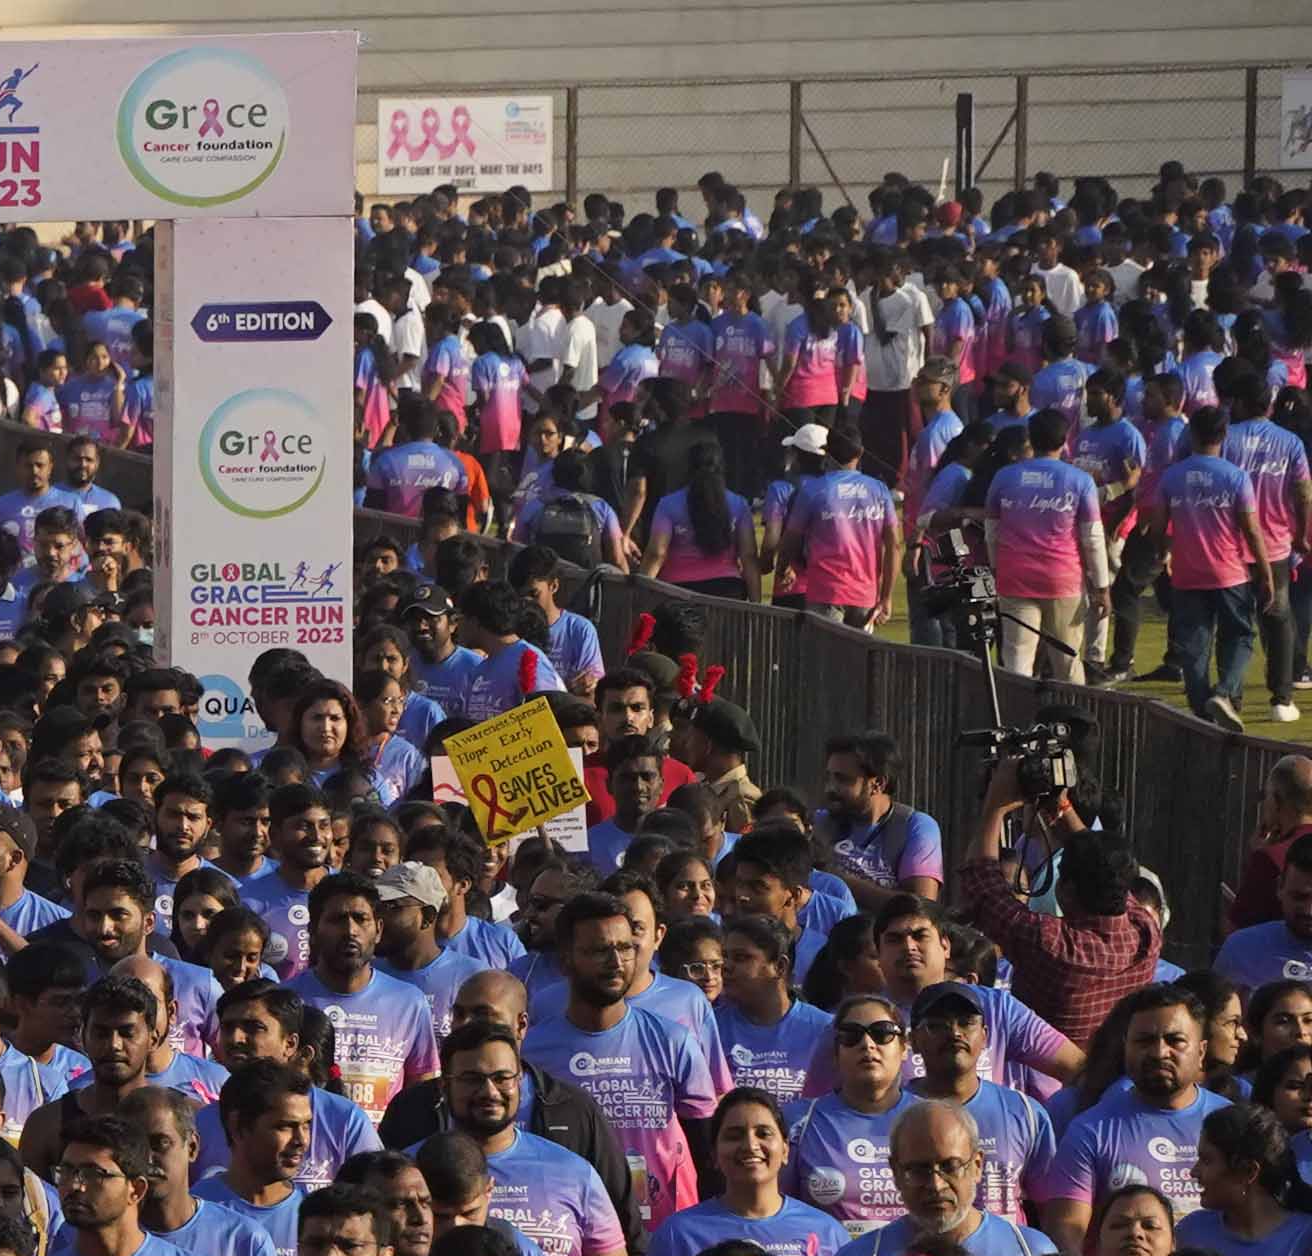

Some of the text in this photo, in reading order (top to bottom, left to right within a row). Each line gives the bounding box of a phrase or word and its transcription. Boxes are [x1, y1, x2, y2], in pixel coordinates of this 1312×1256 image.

[144, 140, 273, 153] Cancer foundation
[206, 312, 314, 331] 6th EDITION
[218, 463, 317, 474] Cancer foundation
[190, 562, 286, 582] GLOBAL
[190, 584, 306, 603] GRACE
[190, 605, 344, 627] CANCER RUN
[213, 631, 289, 644] OCTOBER
[296, 628, 344, 644] 2023
[204, 697, 255, 715] QUA
[452, 716, 509, 750] Awareness
[457, 726, 533, 766] Hope Early
[490, 738, 553, 773] Detection
[500, 763, 558, 803] SAVES
[528, 777, 585, 817] LIVES
[736, 1066, 792, 1079] GLOBAL
[603, 1105, 667, 1117] NCER RUN
[643, 1120, 668, 1129] 2023
